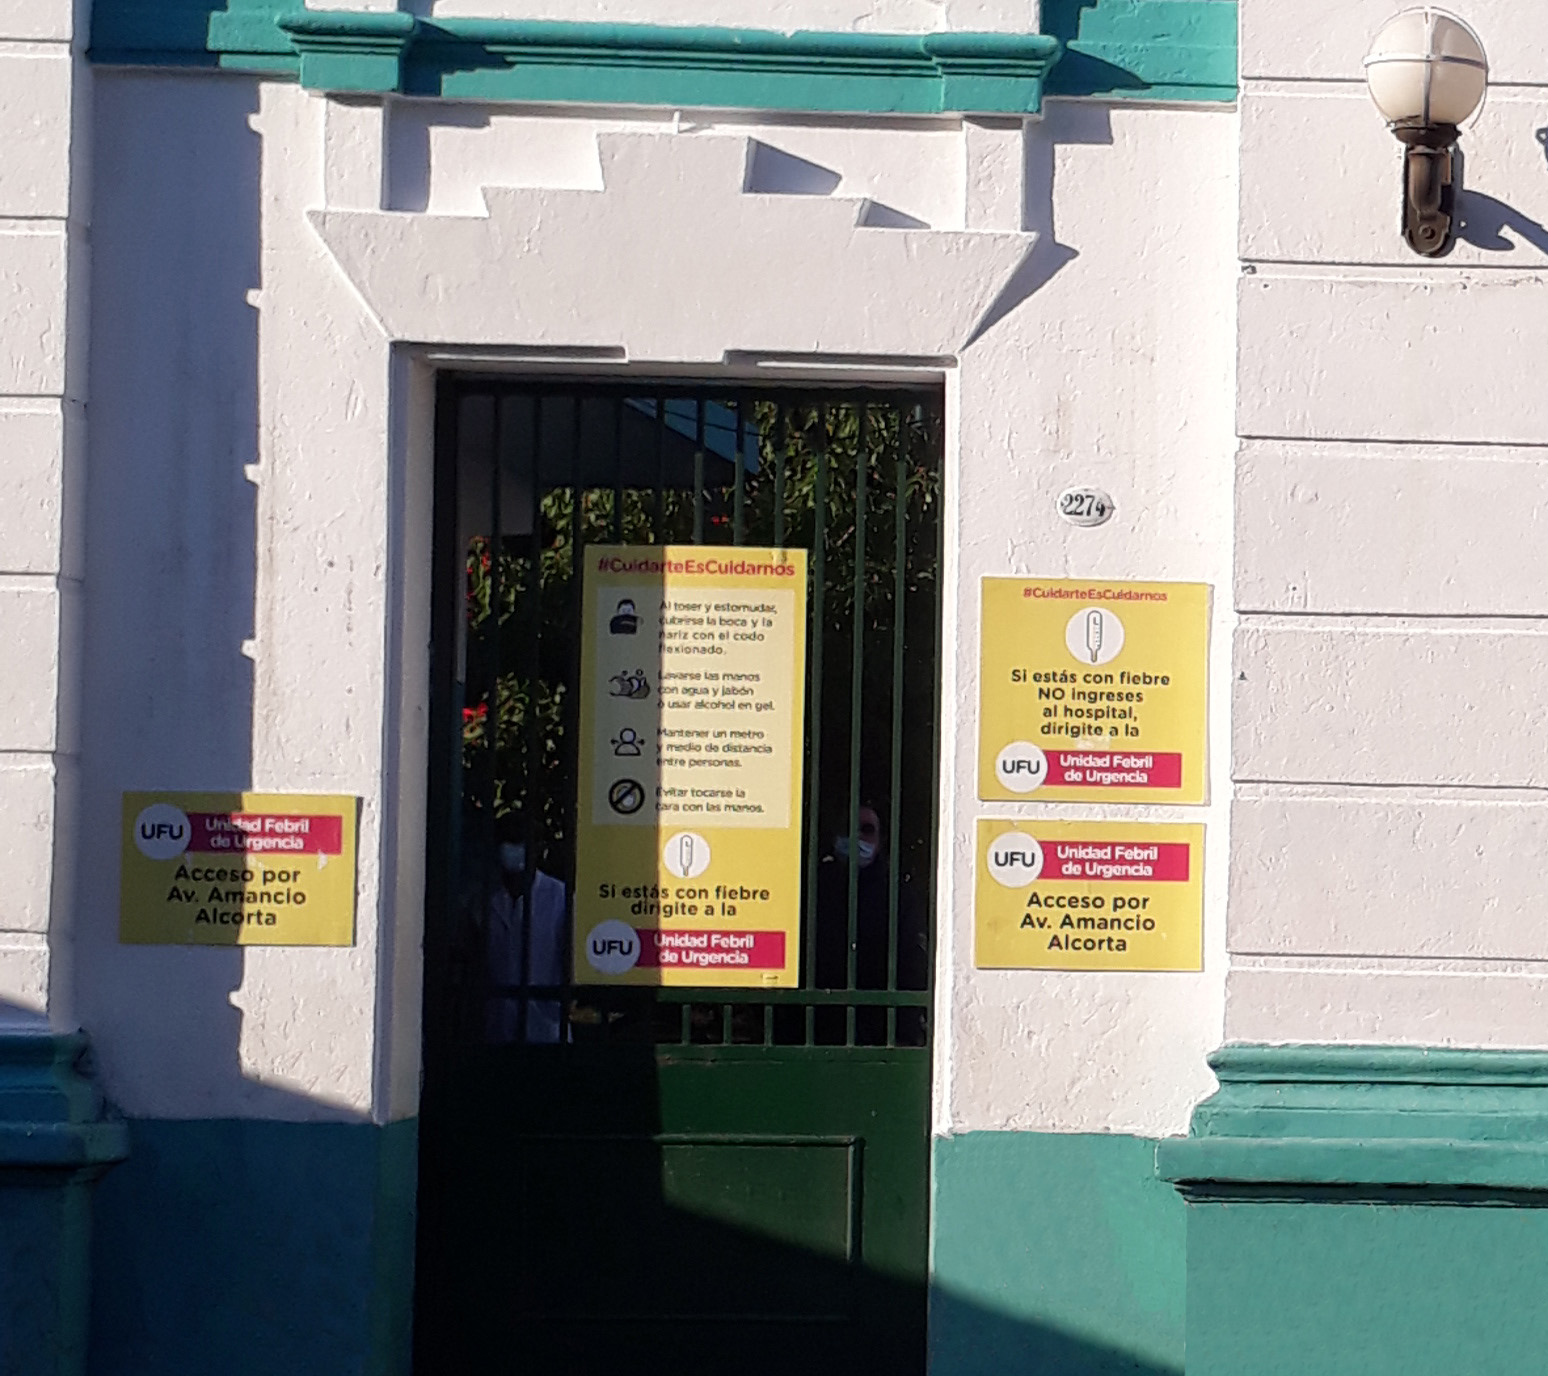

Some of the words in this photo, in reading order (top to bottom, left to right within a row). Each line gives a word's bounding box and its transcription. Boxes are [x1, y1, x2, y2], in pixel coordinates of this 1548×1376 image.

[1060, 492, 1105, 517] 2274
[598, 558, 795, 577] #CuidarteEsCuidarnos
[674, 602, 702, 612] toser
[704, 603, 712, 613] y
[706, 616, 716, 626] la
[719, 616, 747, 627] boca
[751, 618, 758, 628] y
[762, 617, 773, 627] la
[693, 631, 715, 640] con
[719, 631, 729, 640] el
[733, 631, 765, 642] codo
[704, 672, 719, 681] las
[722, 673, 760, 682] manos
[1011, 669, 1027, 683] Si
[1033, 671, 1077, 684] estás
[1083, 672, 1113, 684] con
[1119, 672, 1170, 686] fiebre
[681, 687, 709, 697] agua
[712, 688, 720, 697] y
[1038, 687, 1065, 701] NO
[1071, 687, 1143, 703] ingreses
[667, 700, 691, 710] usar
[694, 699, 735, 710] alcohol
[738, 702, 751, 710] en
[1043, 705, 1057, 718] al
[1063, 705, 1138, 721] hospital,
[712, 730, 727, 739] un
[729, 729, 764, 739] metro
[1040, 722, 1103, 738] dirigite
[1109, 726, 1119, 736] a
[1125, 724, 1139, 737] la
[666, 743, 702, 753] medio
[705, 743, 719, 753] de
[722, 743, 773, 754] distancia
[1003, 759, 1040, 774] UFU
[1060, 755, 1110, 768] Unidad
[1113, 756, 1152, 769] Febril
[1065, 771, 1082, 782] de
[1085, 771, 1147, 784] Urgencia
[655, 786, 688, 798] Evitar
[690, 787, 733, 798] tocarse
[736, 788, 746, 799] la
[682, 803, 703, 812] con
[706, 802, 721, 812] las
[724, 804, 764, 813] manos.
[141, 823, 184, 840] UFU
[205, 817, 261, 832] Unidad
[265, 818, 309, 834] Febril
[210, 835, 229, 849] de
[234, 835, 303, 851] Urgencia
[995, 851, 1035, 868] UFU
[1057, 845, 1111, 860] Unidad
[1114, 846, 1158, 861] Febril
[174, 865, 254, 882] Acceso
[262, 869, 301, 886] por
[1062, 862, 1081, 875] de
[1085, 862, 1153, 878] Urgencia
[166, 887, 198, 903] Av.
[207, 887, 306, 906] Amancio
[621, 884, 669, 899] estás
[675, 887, 709, 899] con
[715, 885, 770, 901] fiebre
[1027, 891, 1105, 909] Acceso
[1113, 896, 1150, 912] por
[194, 908, 276, 926] Alcorta
[631, 902, 698, 918] dirigite
[704, 905, 715, 916] a
[721, 902, 737, 917] la
[1020, 913, 1051, 929] Av.
[1059, 913, 1155, 931] Amancio
[592, 939, 633, 956] UFU
[654, 933, 707, 948] Unidad
[711, 934, 754, 949] Febril
[1047, 934, 1127, 952] Alcorta
[658, 951, 679, 964] de
[681, 951, 749, 966] Urgencia
